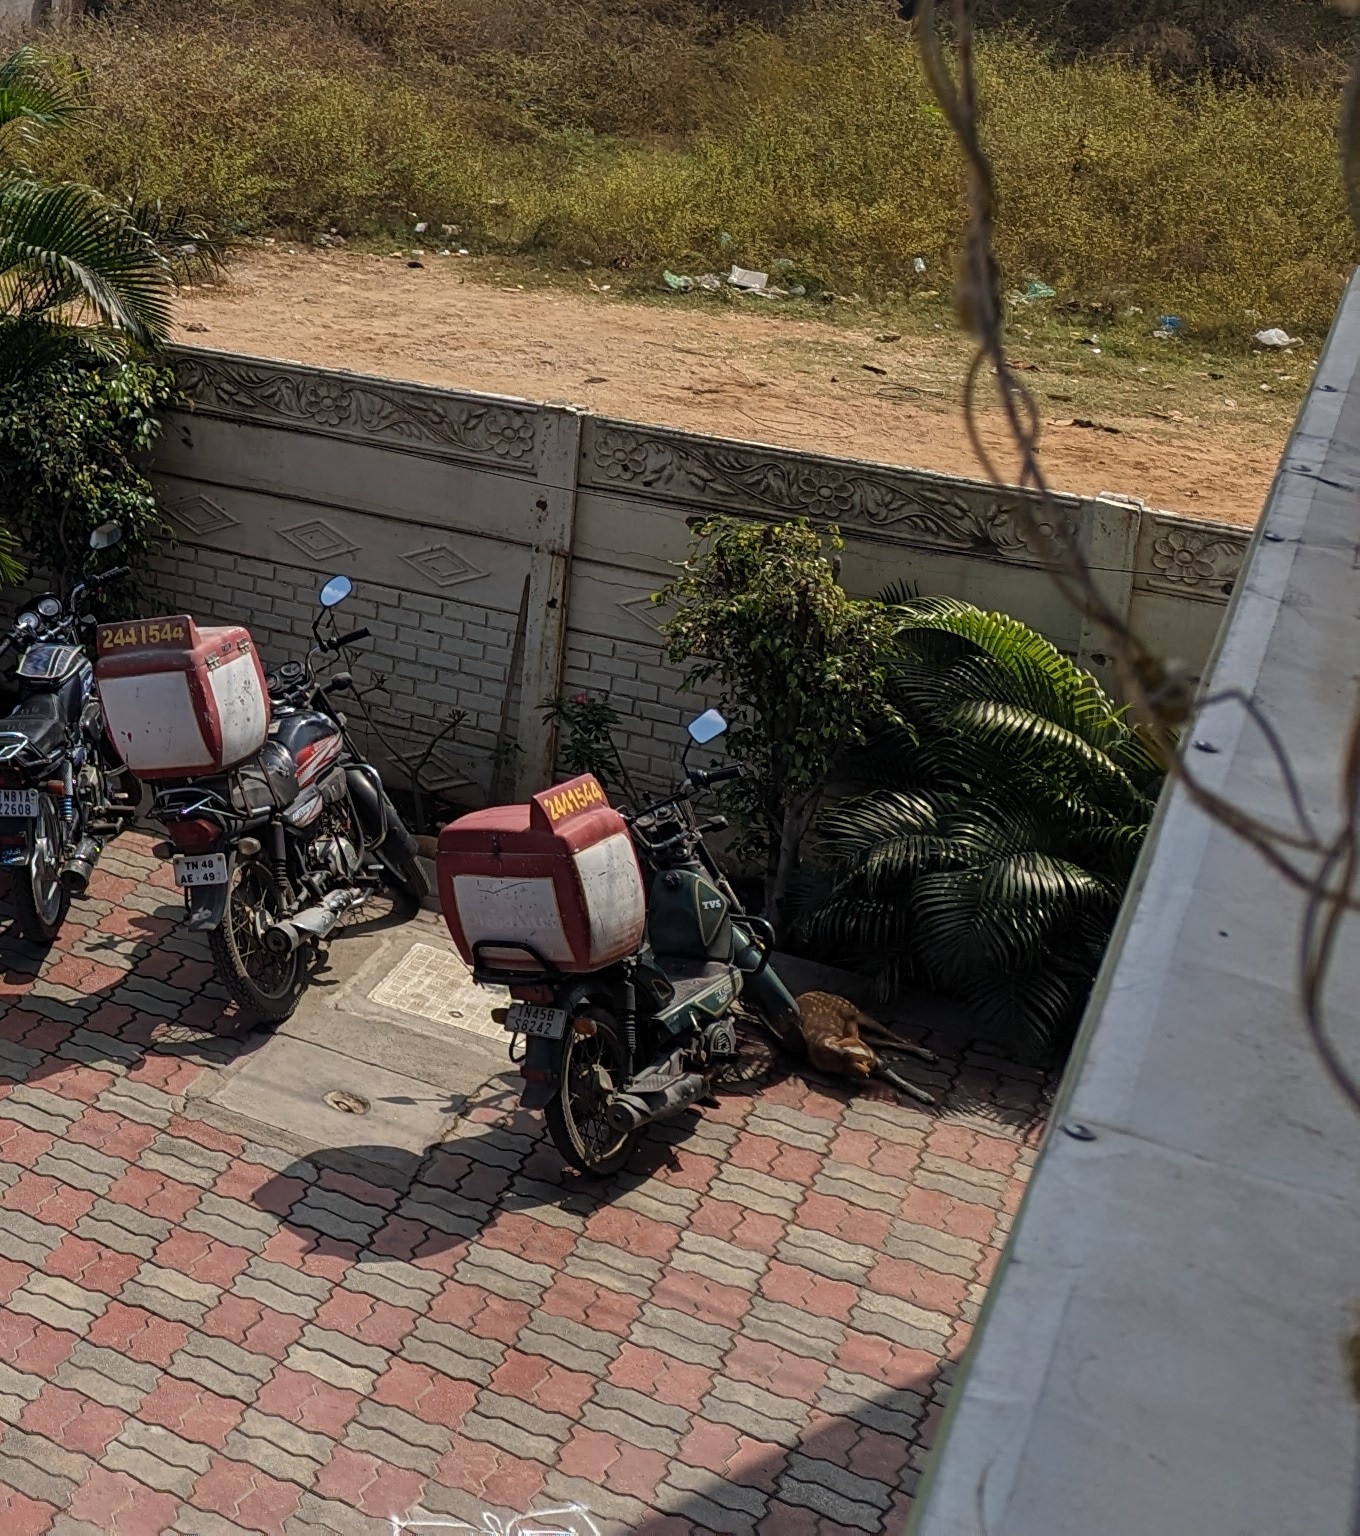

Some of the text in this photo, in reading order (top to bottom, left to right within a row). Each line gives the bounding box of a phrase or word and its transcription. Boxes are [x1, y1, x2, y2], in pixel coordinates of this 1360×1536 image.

[102, 622, 185, 649] 2441544
[543, 781, 603, 821] 2441544
[184, 859, 214, 871] TN 48
[181, 874, 194, 884] AE
[701, 899, 722, 910] TVS
[518, 1005, 555, 1022] TN45B
